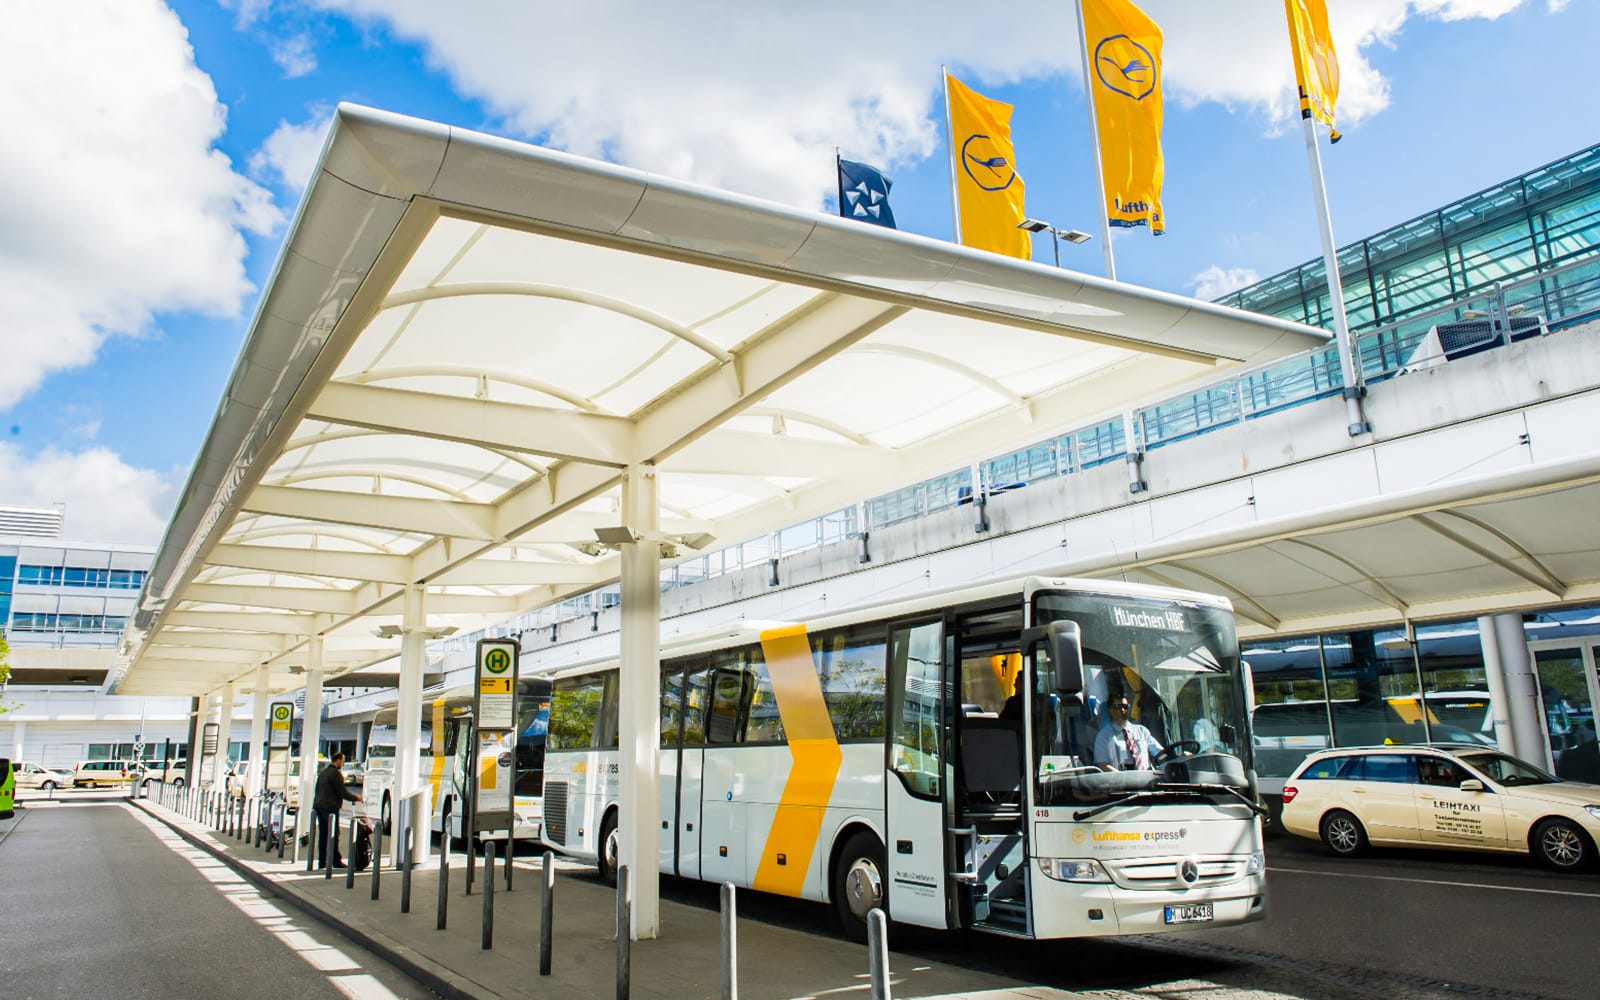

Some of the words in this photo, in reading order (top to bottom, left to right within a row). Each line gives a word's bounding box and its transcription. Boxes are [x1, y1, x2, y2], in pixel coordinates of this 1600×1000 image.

[1113, 606, 1166, 629] München
[504, 679, 510, 692] 1
[1433, 800, 1480, 811] LEIHTAXI
[1035, 809, 1049, 818] 418
[1092, 829, 1141, 841] Lufthansa
[1144, 831, 1179, 842] express
